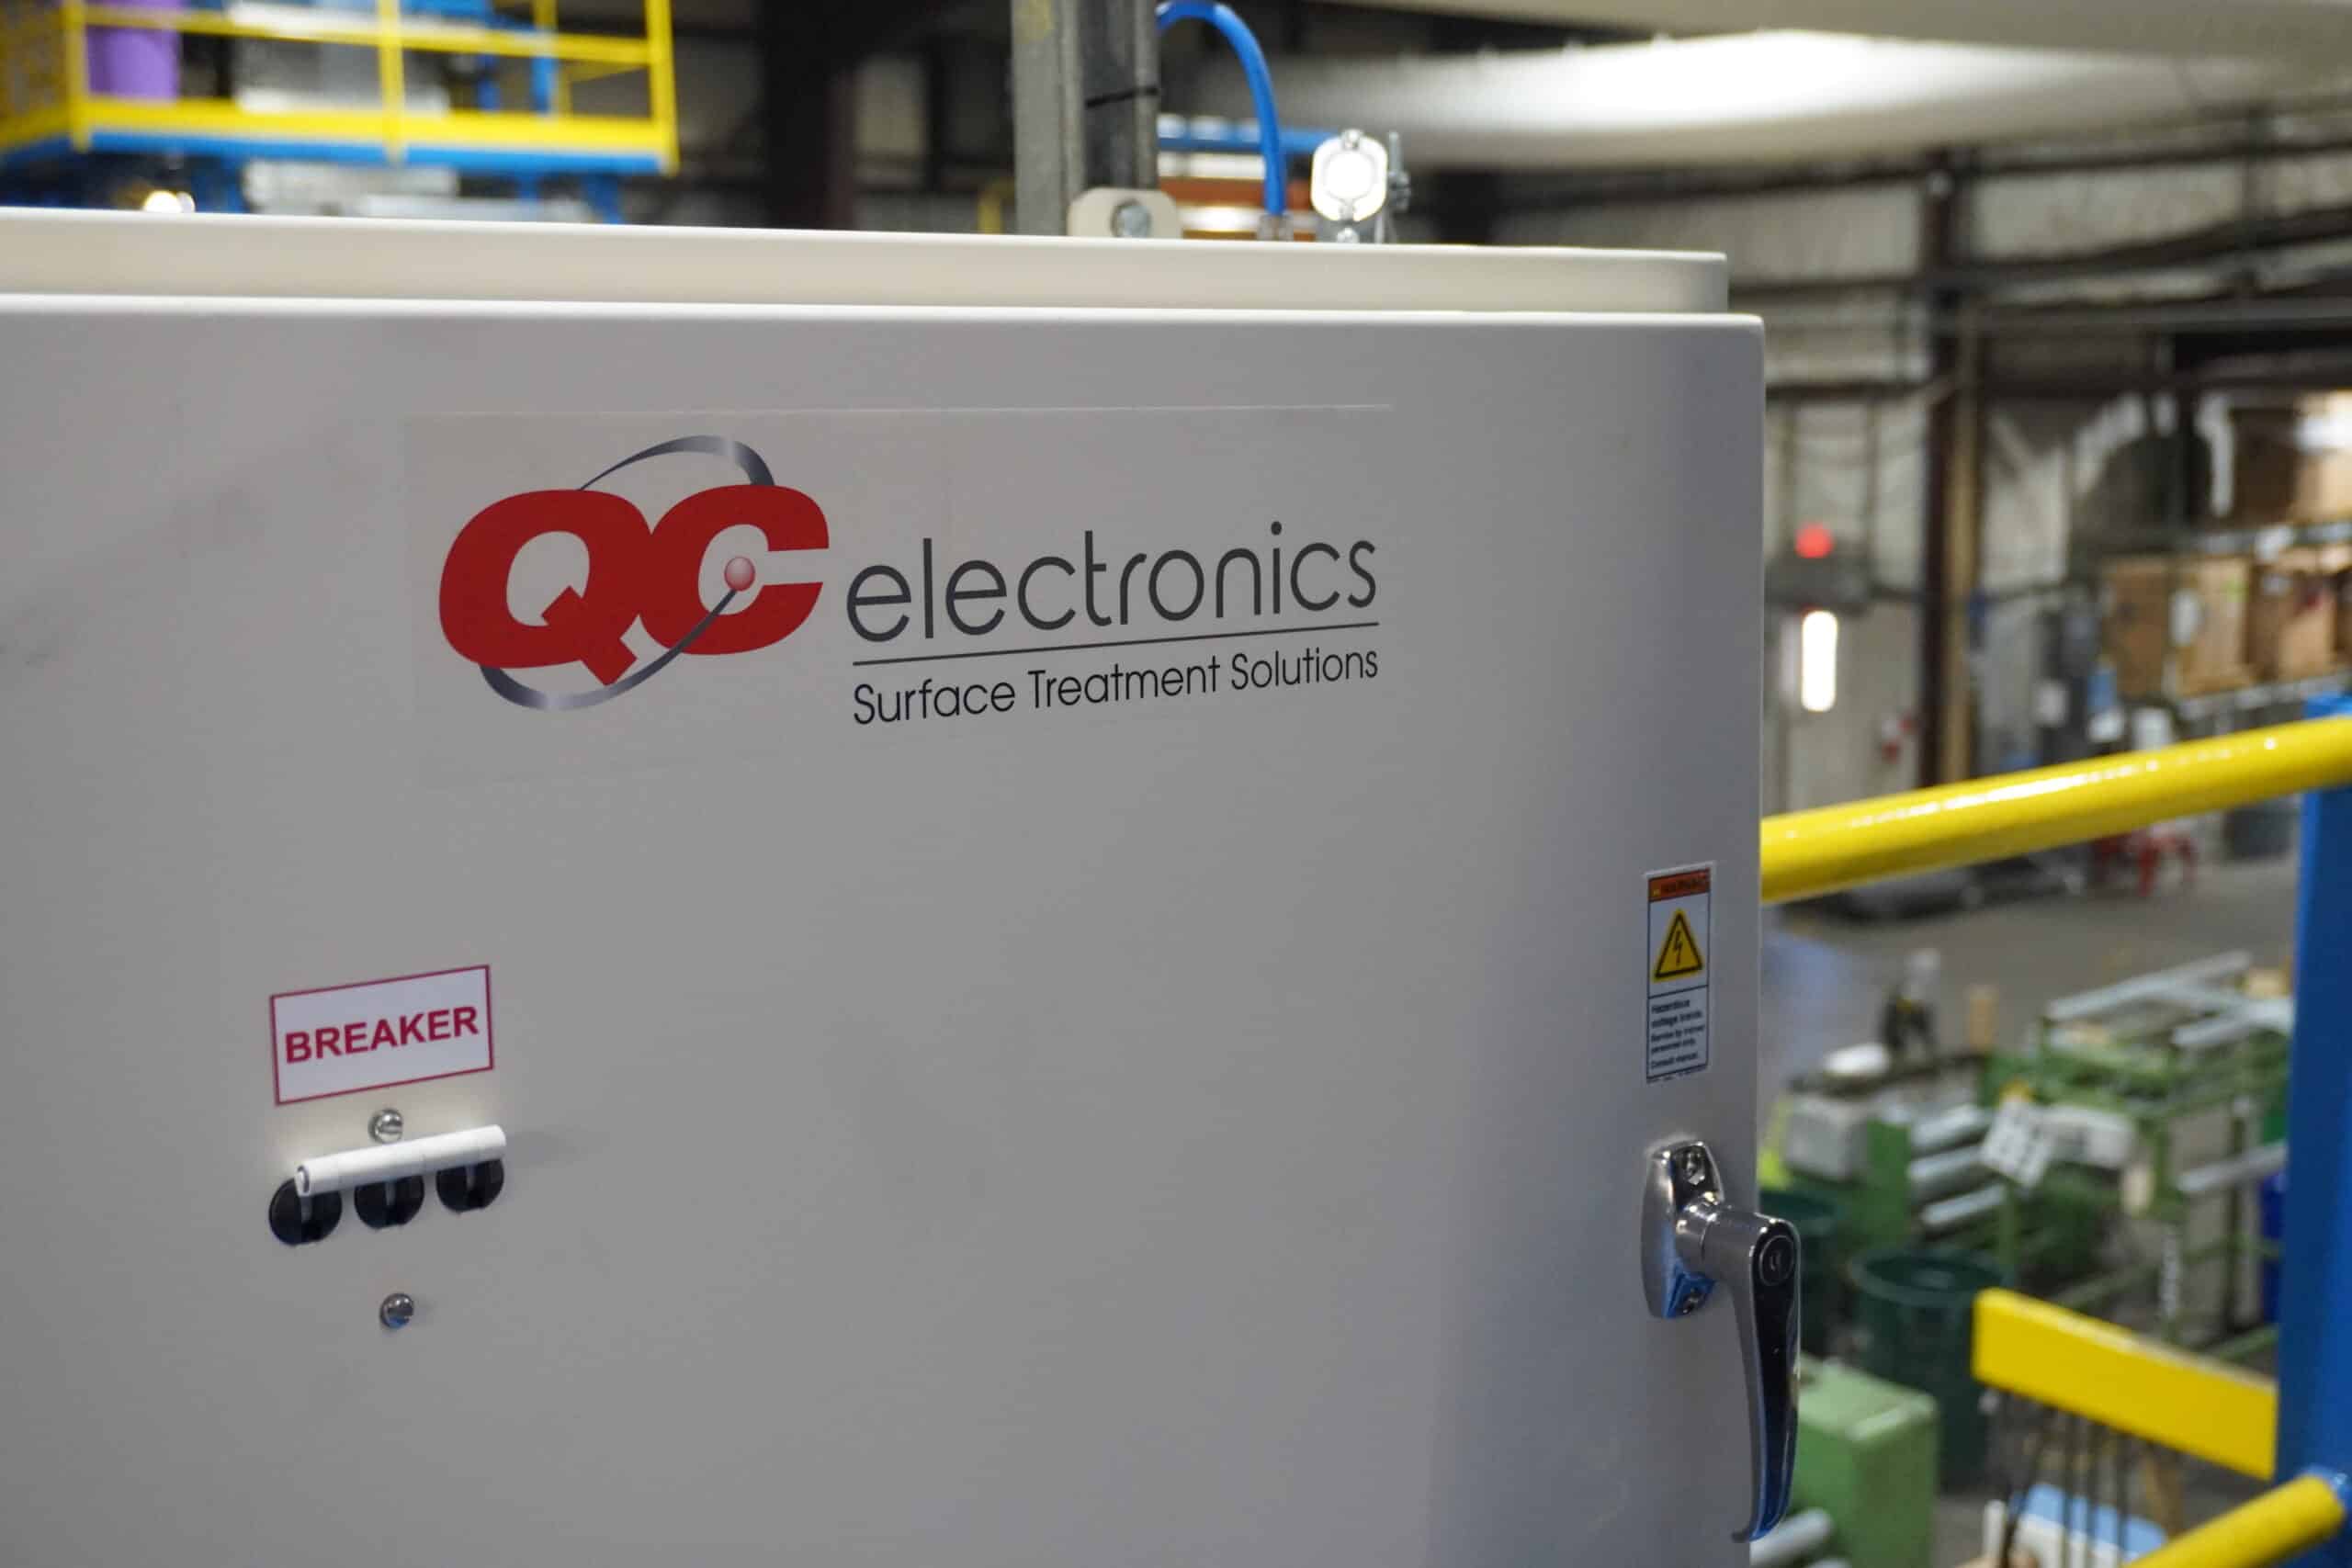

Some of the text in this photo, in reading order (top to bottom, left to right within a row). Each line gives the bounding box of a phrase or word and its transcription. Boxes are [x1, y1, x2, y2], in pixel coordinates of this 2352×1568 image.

[439, 483, 1377, 686] QC electronics
[853, 647, 1379, 726] Surface Treatment Solutions
[285, 1006, 479, 1064] BREAKER
